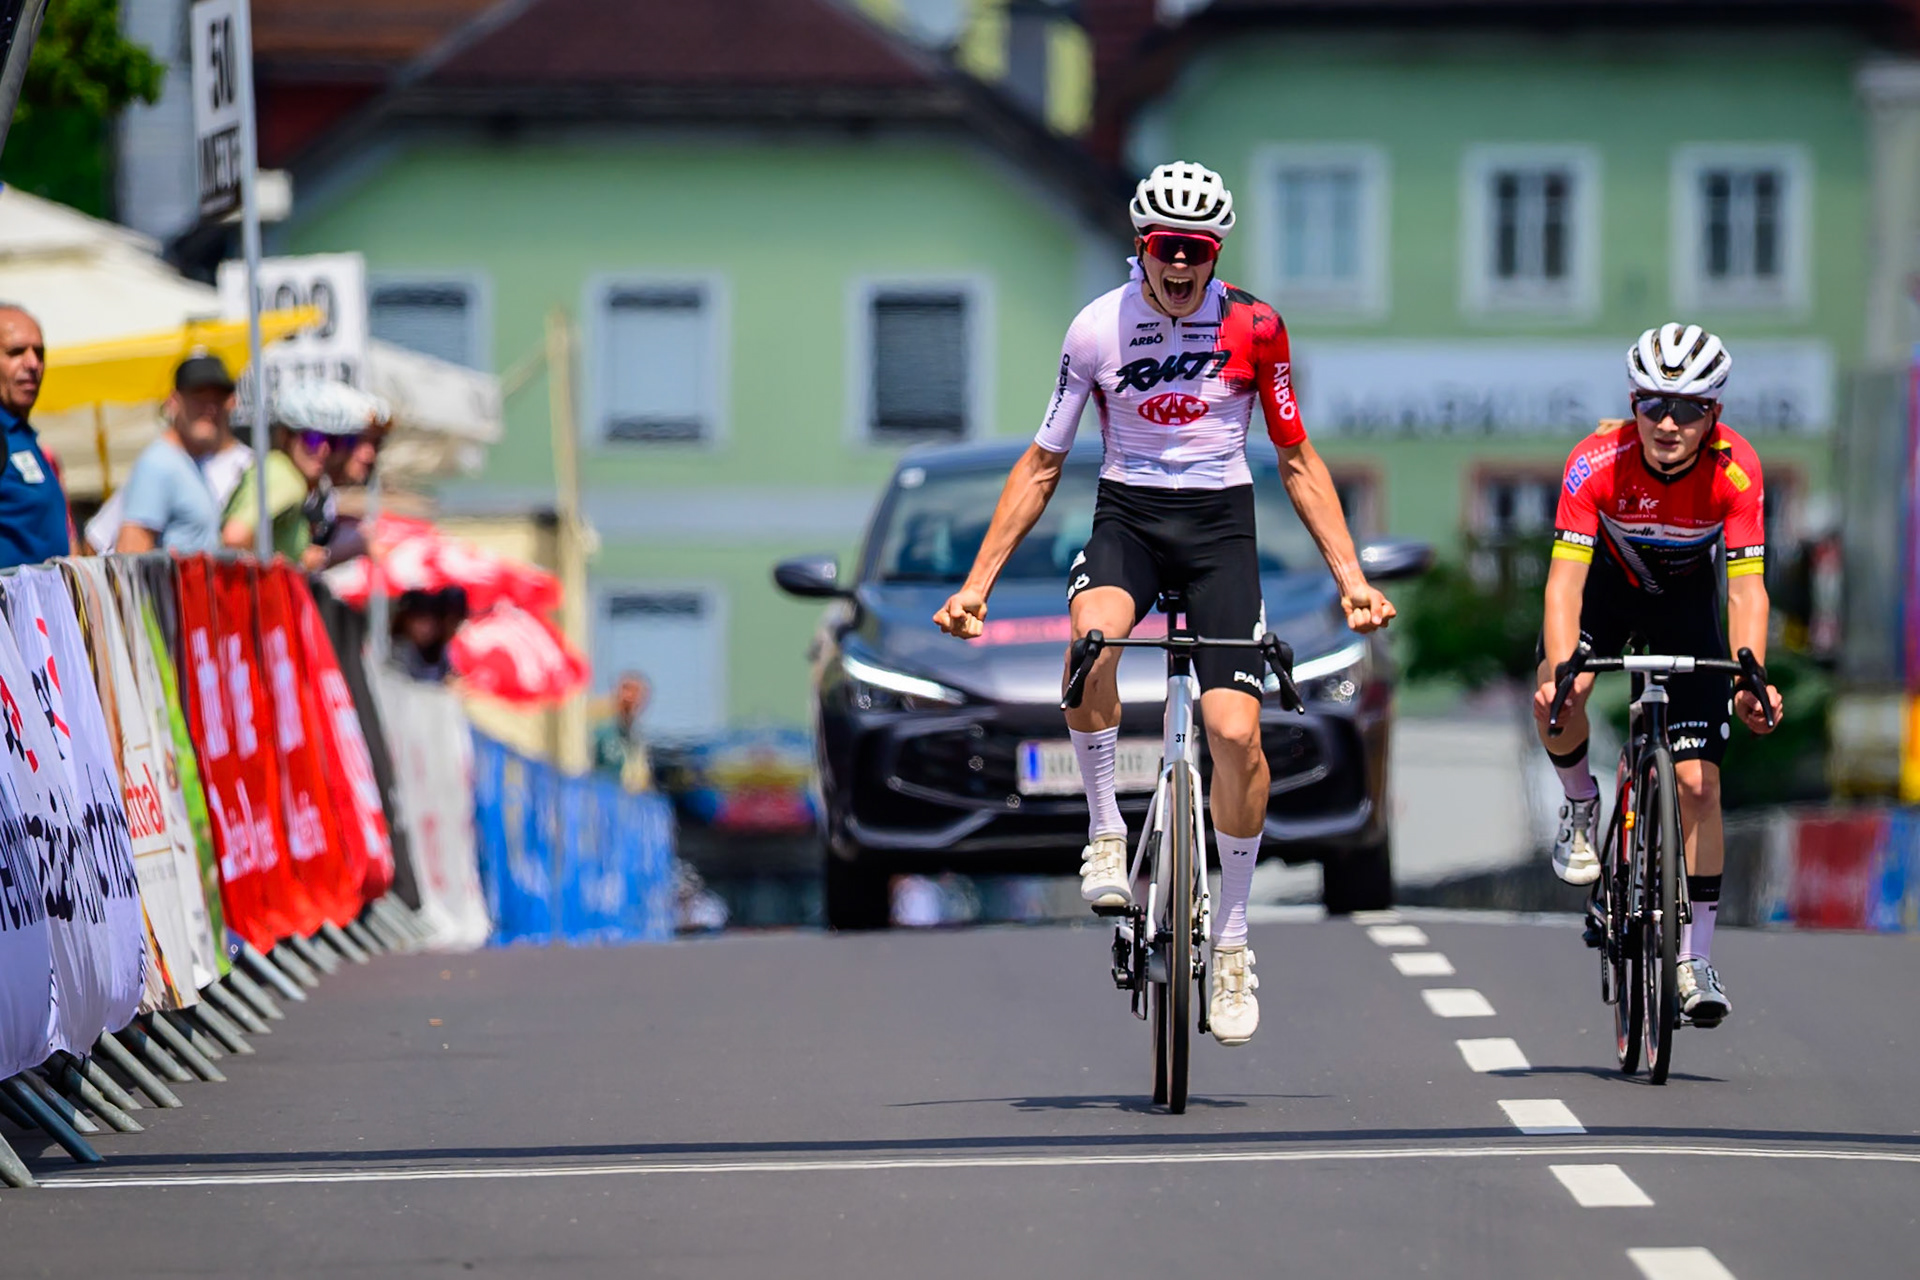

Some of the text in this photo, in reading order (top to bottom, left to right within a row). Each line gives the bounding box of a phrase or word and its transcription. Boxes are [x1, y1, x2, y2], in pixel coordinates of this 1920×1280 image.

[1129, 333, 1164, 347] ARBÖ
[1274, 362, 1296, 420] ARBÖ
[1562, 530, 1594, 547] KOCH
[1175, 733, 1186, 743] 3T
